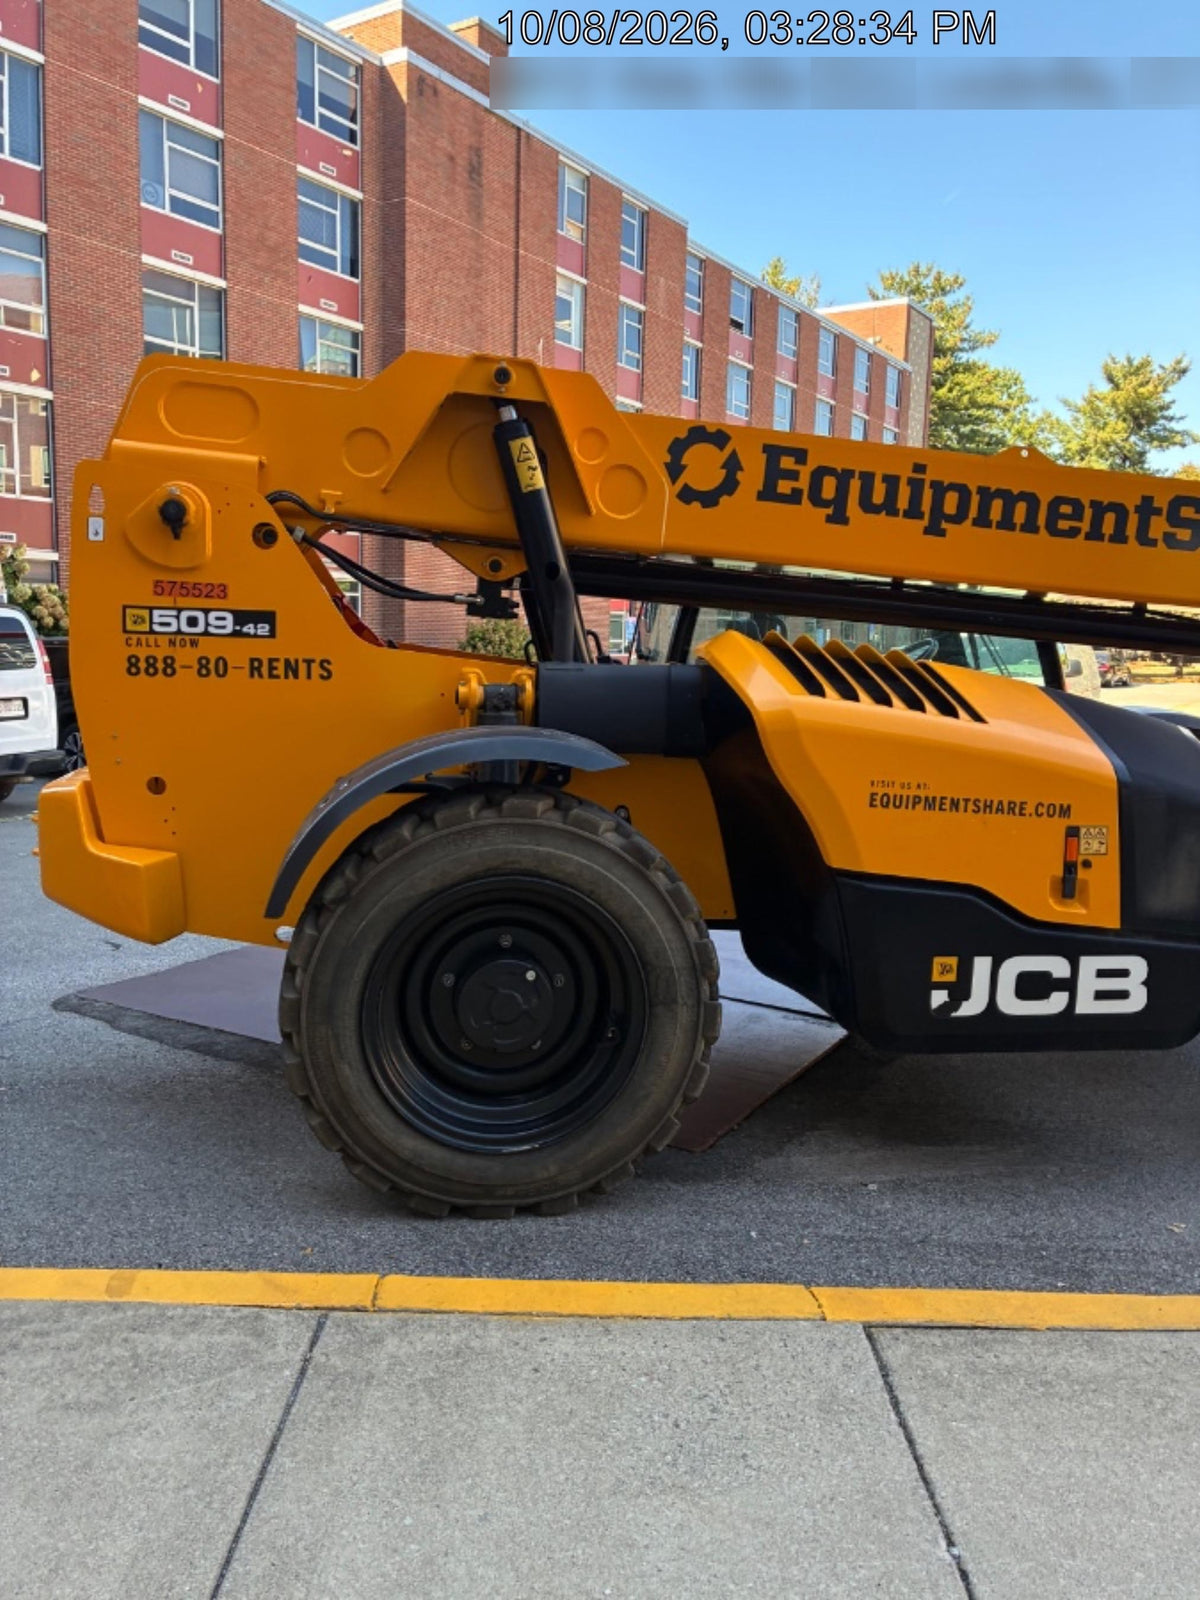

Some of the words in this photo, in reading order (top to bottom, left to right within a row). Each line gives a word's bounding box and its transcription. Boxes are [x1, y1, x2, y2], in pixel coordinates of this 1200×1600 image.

[757, 443, 1200, 551] EquipmentS
[153, 580, 228, 599] 575523
[151, 609, 271, 636] 509-42
[125, 637, 161, 648] CALL
[168, 638, 200, 649] NOW
[870, 780, 896, 789] VISIT
[900, 781, 912, 790] US
[868, 792, 1072, 819] EQUIPMENTSHARE.COM
[930, 955, 1149, 1017] JCB
